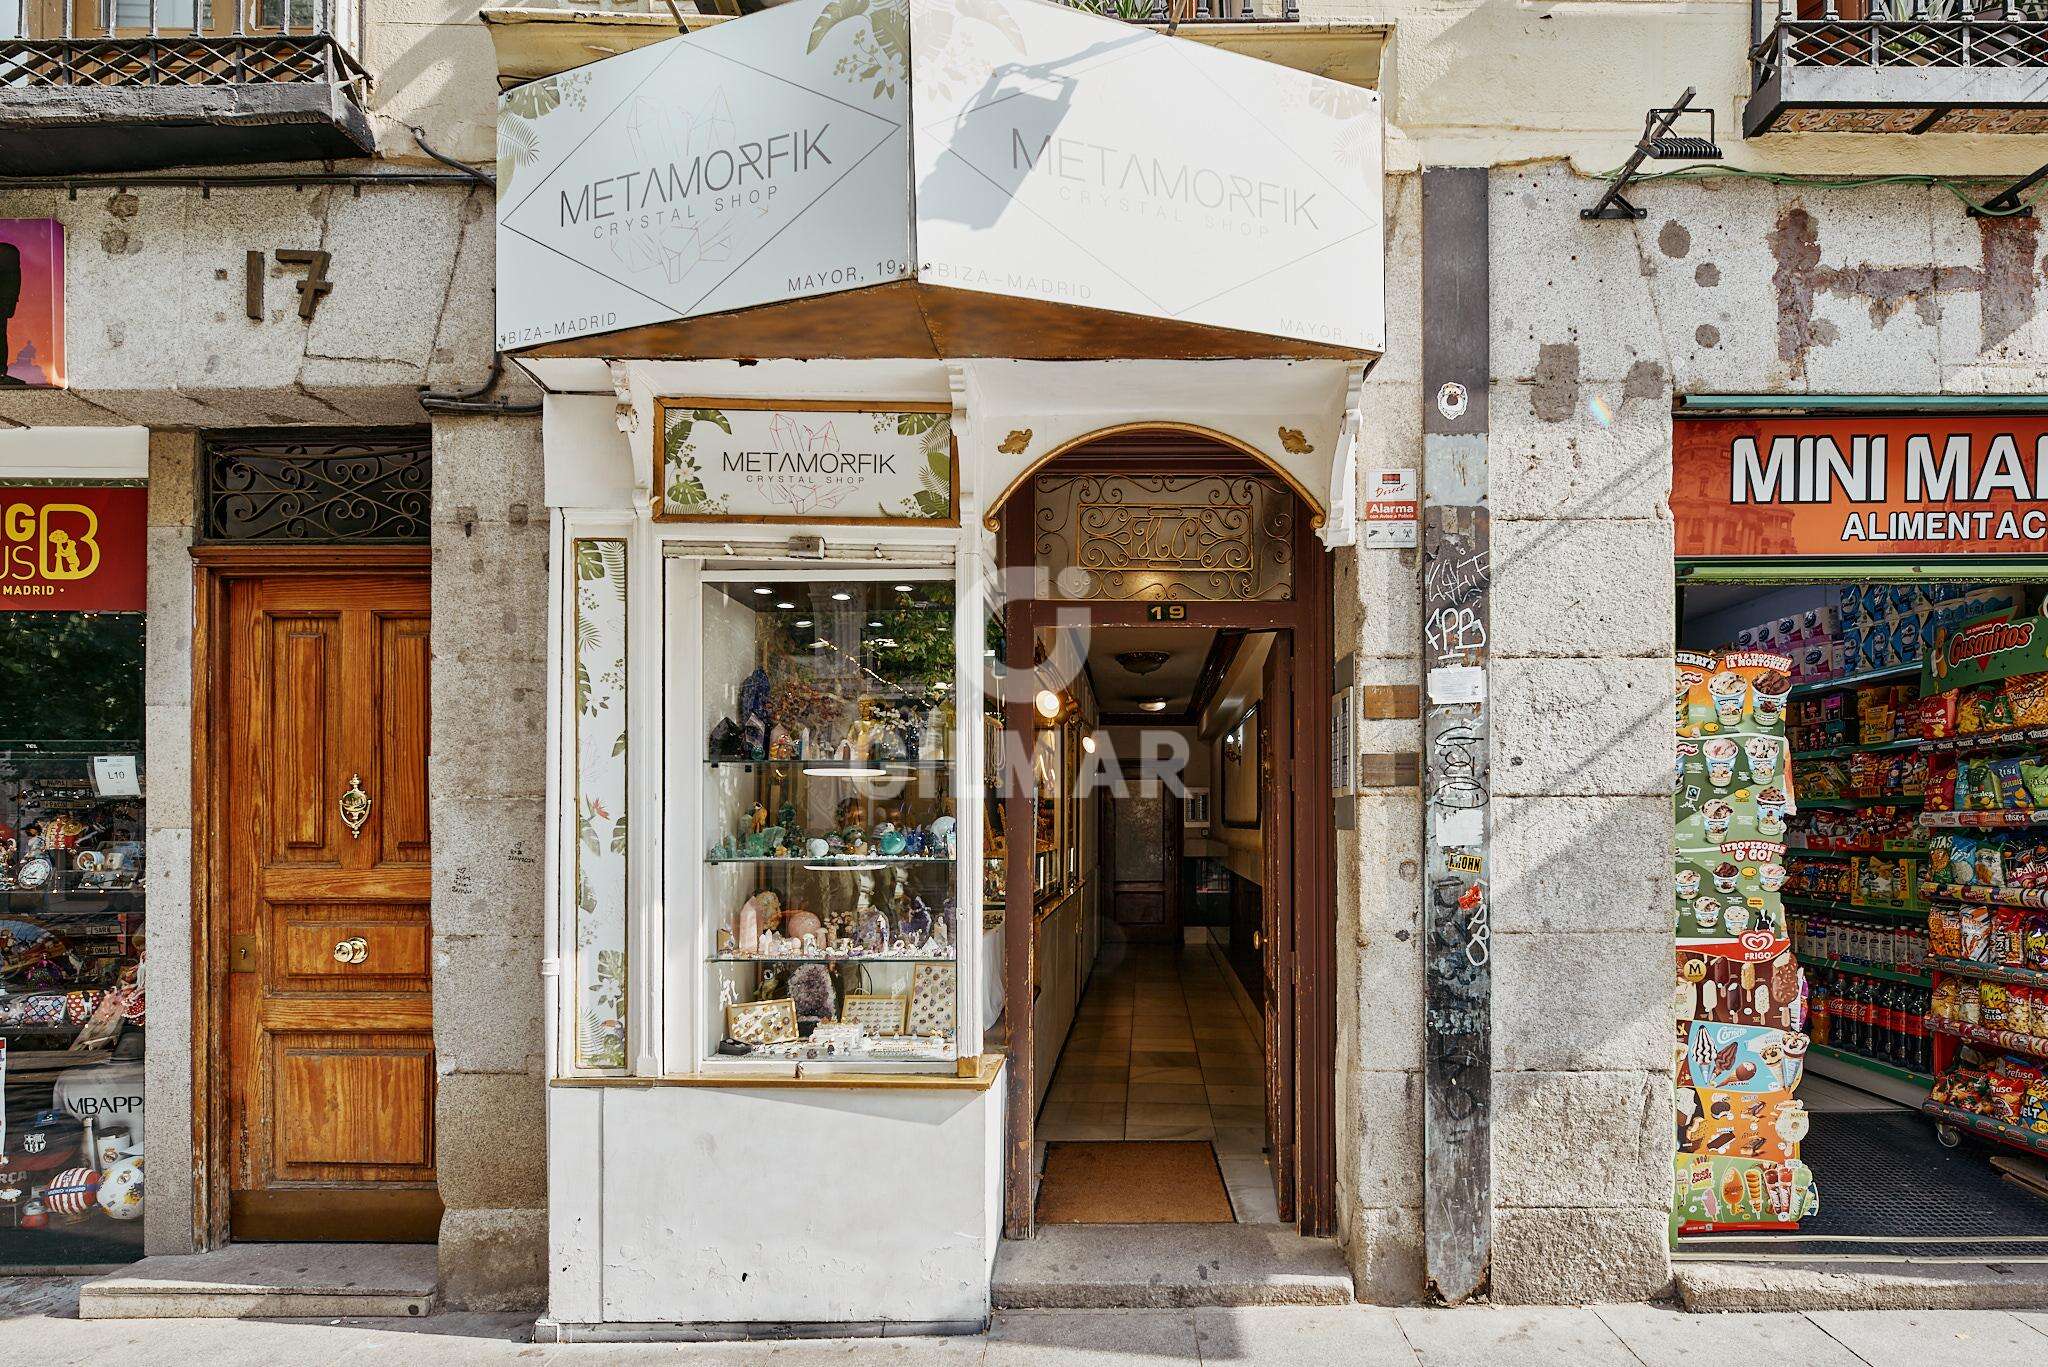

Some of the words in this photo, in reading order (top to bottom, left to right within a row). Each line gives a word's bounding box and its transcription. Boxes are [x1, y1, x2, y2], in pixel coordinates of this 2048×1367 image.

[560, 123, 832, 228] METAMORFIK
[1012, 127, 1320, 230] METAMORFIK
[593, 208, 696, 240] CRYSTAL
[714, 185, 778, 212] SHOP
[1058, 186, 1182, 222] CRYSTAL
[1206, 215, 1271, 239] SHOP
[246, 249, 333, 321] 17
[723, 451, 897, 475] METAMORFIK
[1730, 434, 1889, 505] MINI
[746, 475, 814, 484] CRYSTAL
[826, 476, 865, 484] SHOP
[1370, 503, 1414, 514] Alarma
[0, 502, 36, 542] G
[2, 585, 55, 596] MADRID
[1150, 605, 1185, 621] 19
[1748, 848, 1772, 862] GO!
[1744, 952, 1772, 961] FRIGO
[67, 1096, 145, 1116] MBAPP
